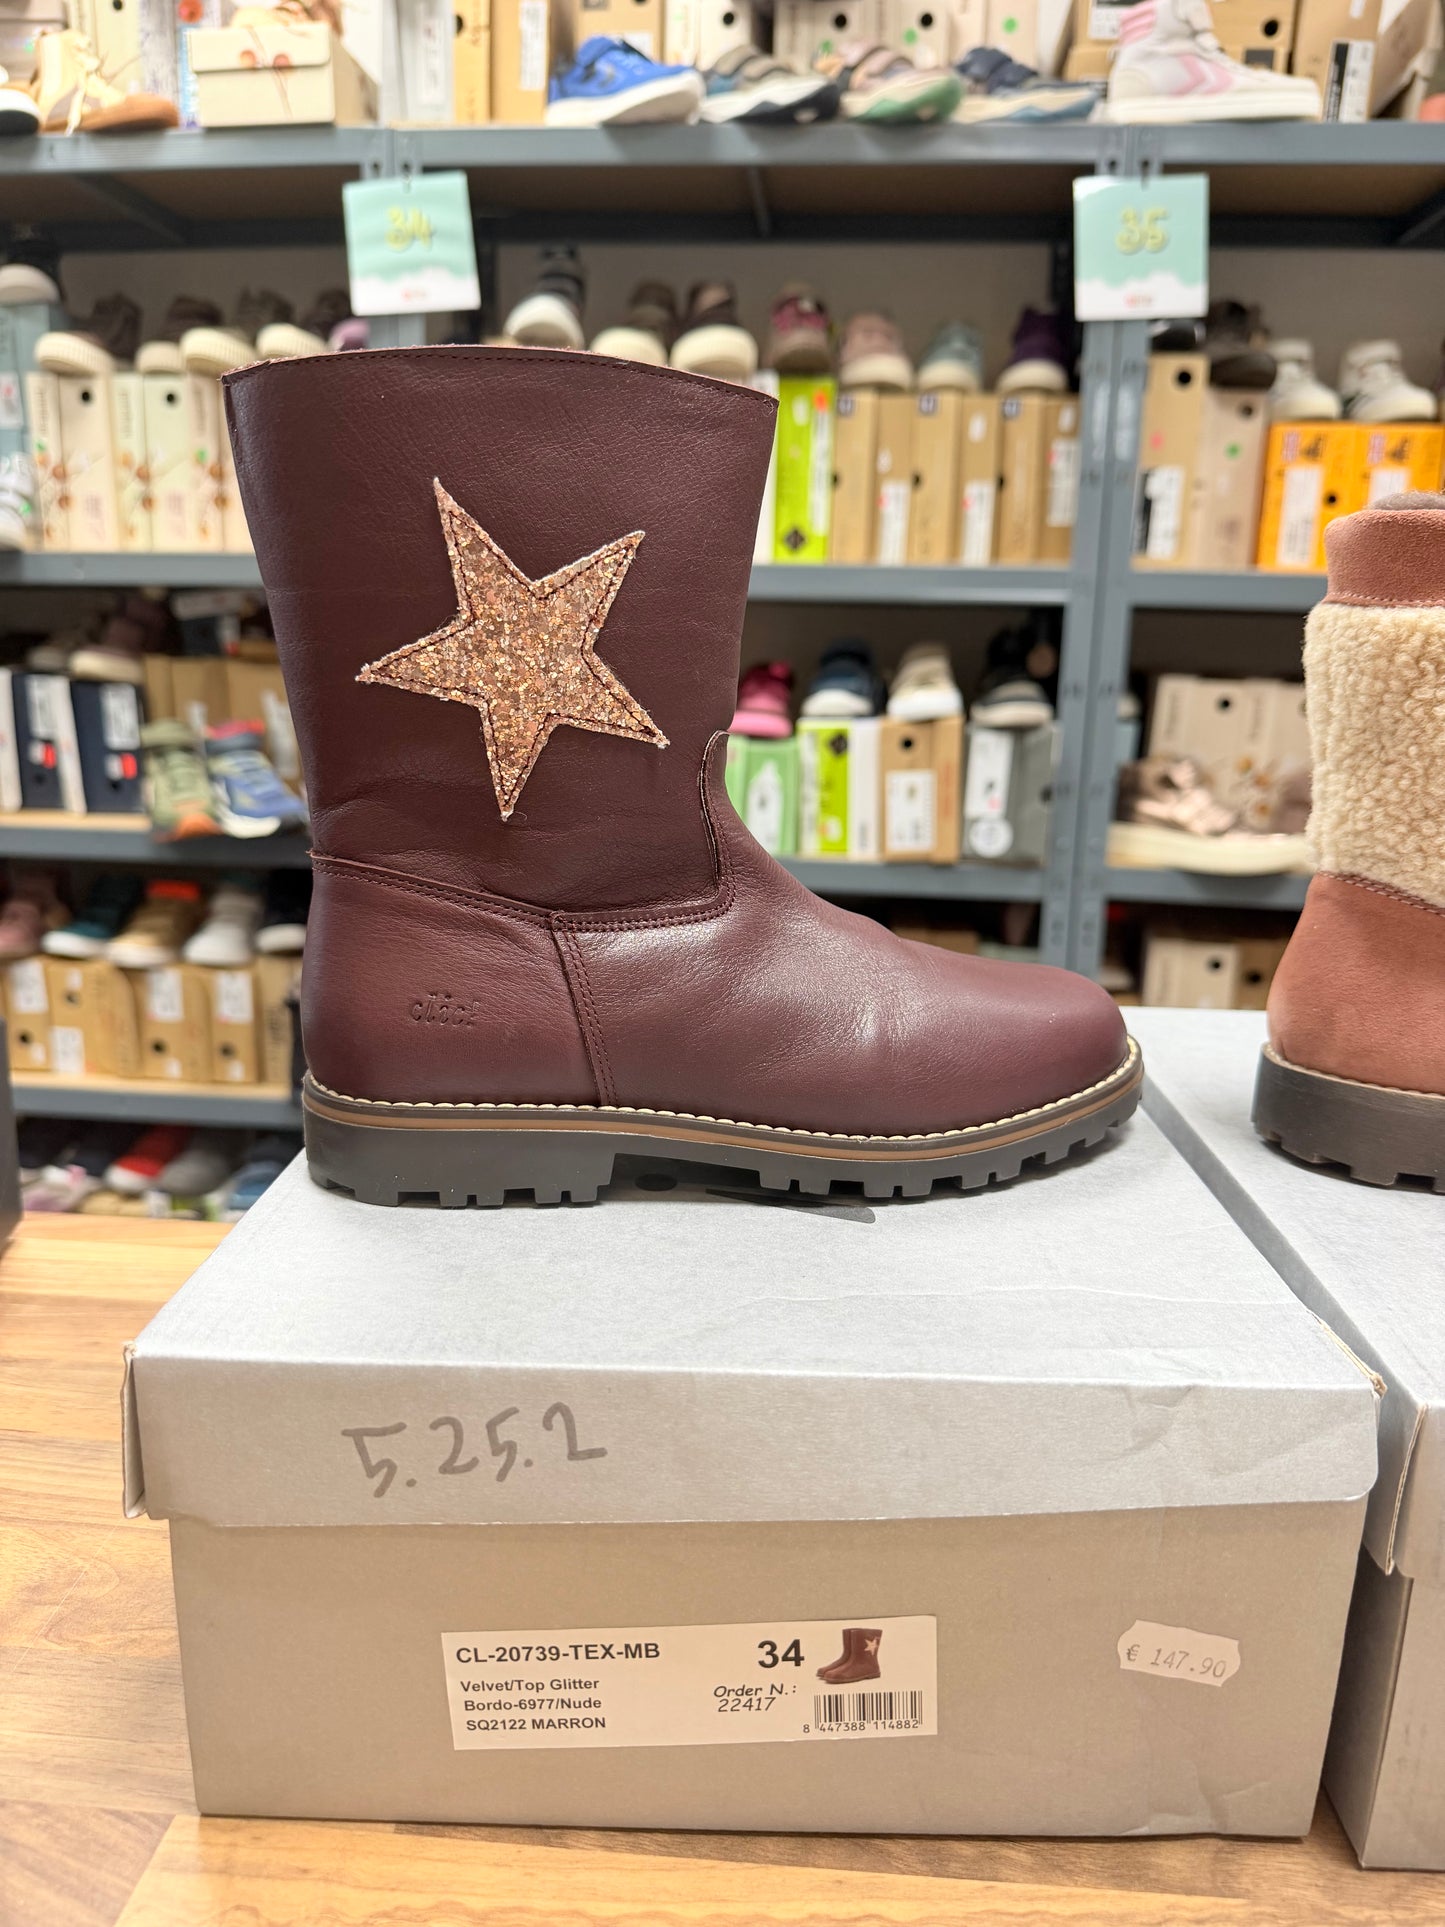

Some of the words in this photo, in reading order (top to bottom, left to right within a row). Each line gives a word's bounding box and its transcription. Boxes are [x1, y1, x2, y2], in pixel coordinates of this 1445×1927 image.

[385, 206, 436, 253] 34
[1115, 204, 1170, 255] 35
[341, 1401, 608, 1498] 5.25.2
[456, 1642, 661, 1663] CL-20739-TEX-MB
[757, 1638, 805, 1669] 34
[1126, 1643, 1141, 1662] €
[1150, 1647, 1227, 1678] 147.90
[460, 1679, 545, 1693] Velvet/Top
[550, 1678, 600, 1691] Glitter
[713, 1684, 763, 1698] Order
[769, 1682, 797, 1696] N.:
[464, 1697, 602, 1711] Bordo-6977/Nude
[717, 1696, 776, 1712] 22417
[466, 1719, 527, 1731] SQ2122
[531, 1717, 606, 1730] MARRON
[803, 1723, 811, 1734] 8
[819, 1722, 866, 1733] 447388
[873, 1719, 920, 1731] 114882
